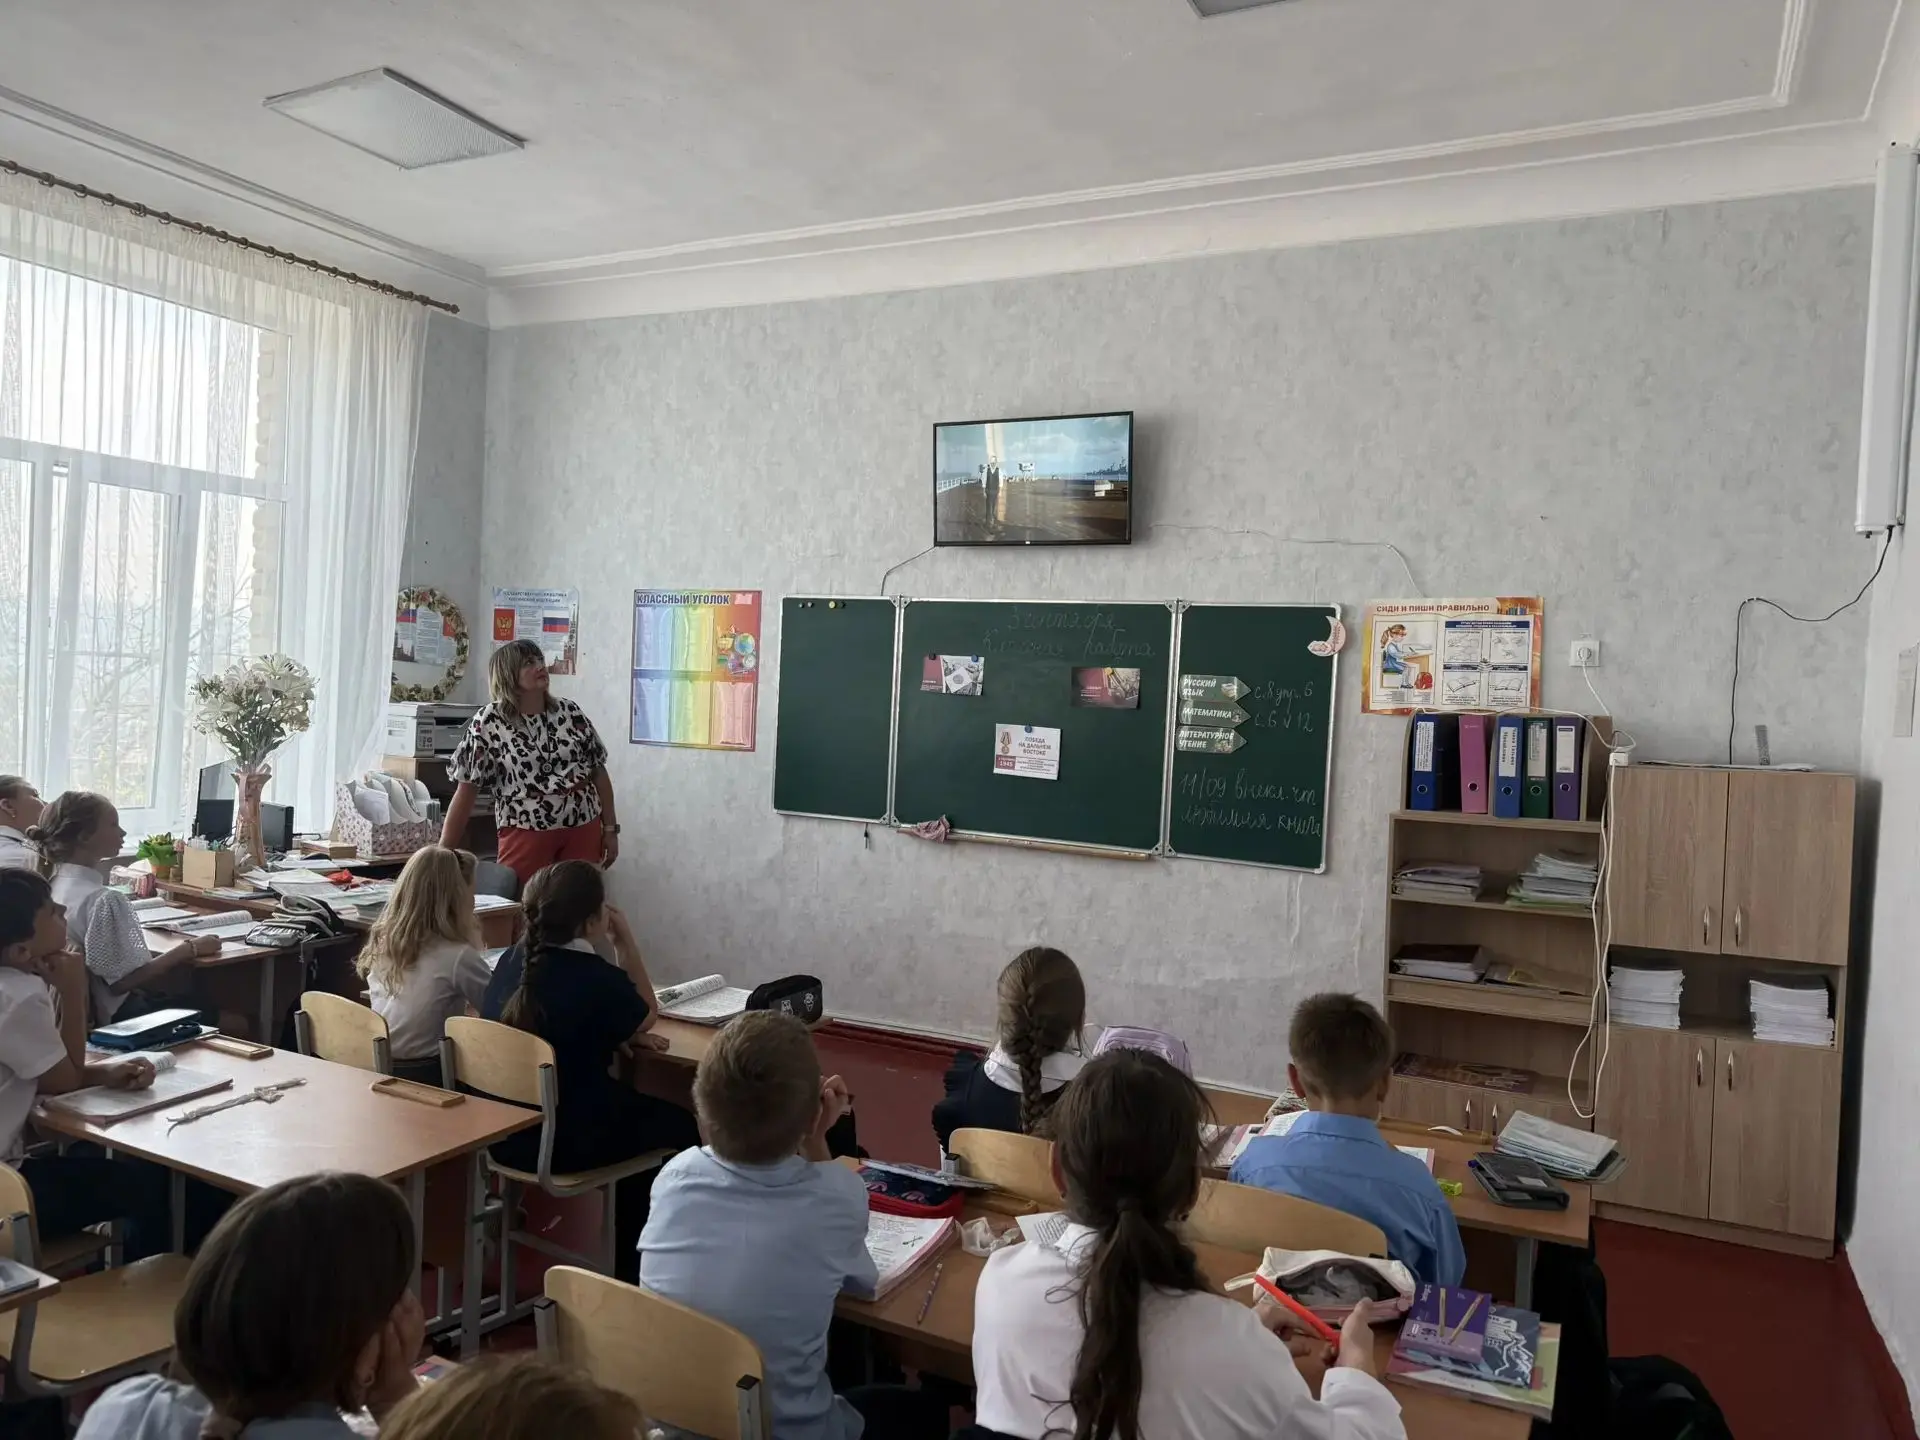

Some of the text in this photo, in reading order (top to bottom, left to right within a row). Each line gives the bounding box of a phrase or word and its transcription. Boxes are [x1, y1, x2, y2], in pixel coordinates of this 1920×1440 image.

[637, 593, 730, 605] КЛАССНЫЙ УГОЛОК
[1376, 605, 1400, 613] СИДИ
[1436, 604, 1490, 612] ПРАВИЛЬНО
[1183, 678, 1217, 688] РУССКИЙ
[1182, 688, 1205, 697] ЯЗЫК
[1182, 706, 1233, 719] МАТЕМАТИКА
[1025, 736, 1046, 744] ПОБЕДА
[1178, 730, 1235, 741] ЛИТЕРАТУРНОЕ
[1026, 742, 1052, 750] ДАЛЬНЕМ
[1178, 740, 1208, 749] ЧТЕНИЕ
[1022, 748, 1047, 757] ВОСТОКЕ
